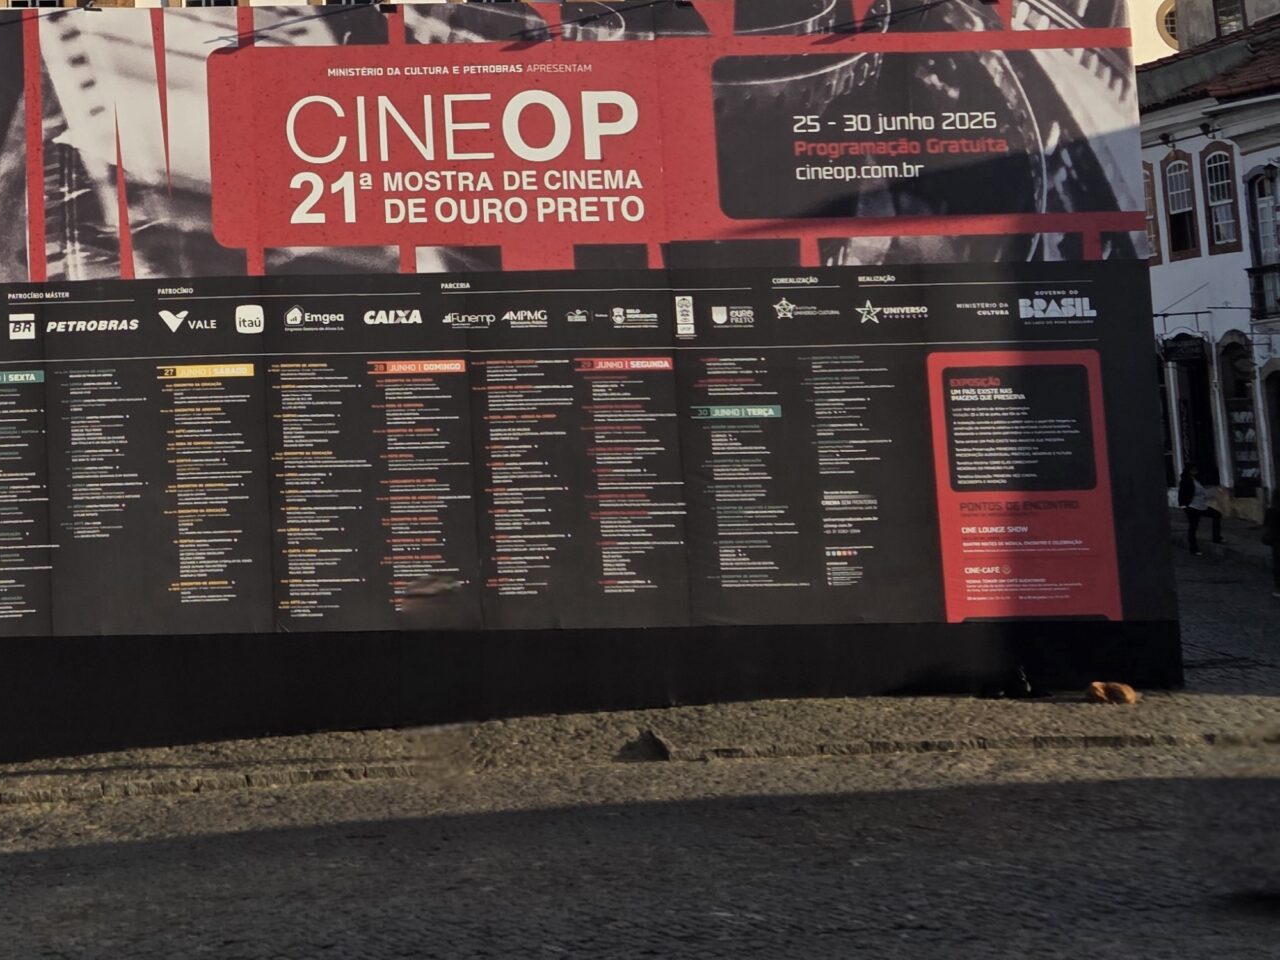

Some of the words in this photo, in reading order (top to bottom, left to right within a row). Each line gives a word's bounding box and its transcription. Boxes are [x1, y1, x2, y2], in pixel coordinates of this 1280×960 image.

[327, 66, 384, 77] MINISTÉRIO
[387, 67, 401, 76] DA
[404, 66, 449, 76] CULTURA
[452, 66, 460, 74] E
[463, 64, 523, 74] PETROBRAS
[526, 63, 592, 73] APRESENTAM
[285, 90, 639, 164] CINEOP
[793, 115, 820, 133] 25
[843, 114, 871, 132] 30
[874, 112, 935, 135] junho
[941, 111, 997, 130] 2026
[794, 138, 921, 158] Programação
[926, 137, 1008, 153] Gratuita
[795, 162, 925, 181] cineop.com.br
[289, 171, 373, 224] 21ª
[383, 170, 494, 192] MOSTRA
[503, 170, 538, 191] DE
[543, 169, 643, 190] CINEMA
[385, 198, 428, 224] DE
[434, 197, 528, 224] OURO
[536, 195, 645, 223] PRETO
[45, 290, 70, 299] MÁSTER
[883, 306, 929, 315] UNIVERSO
[1019, 297, 1097, 318] BRASIL
[238, 316, 262, 328] itaú
[304, 312, 345, 325] Emgea
[363, 309, 423, 325] CAIXA
[451, 311, 496, 326] Funemp
[12, 323, 32, 333] BR
[46, 319, 140, 333] PETROBRAS
[187, 319, 217, 330] VALE
[390, 363, 417, 372] JUNHO
[423, 362, 462, 371] DOMINGO
[595, 360, 623, 369] JUNHO
[630, 360, 670, 369] SEGUNDA
[8, 373, 36, 382] SEXTA
[163, 368, 174, 376] 27
[712, 408, 740, 417] JUNHO
[746, 407, 774, 418] TERÇA
[960, 501, 1002, 512] PONTOS
